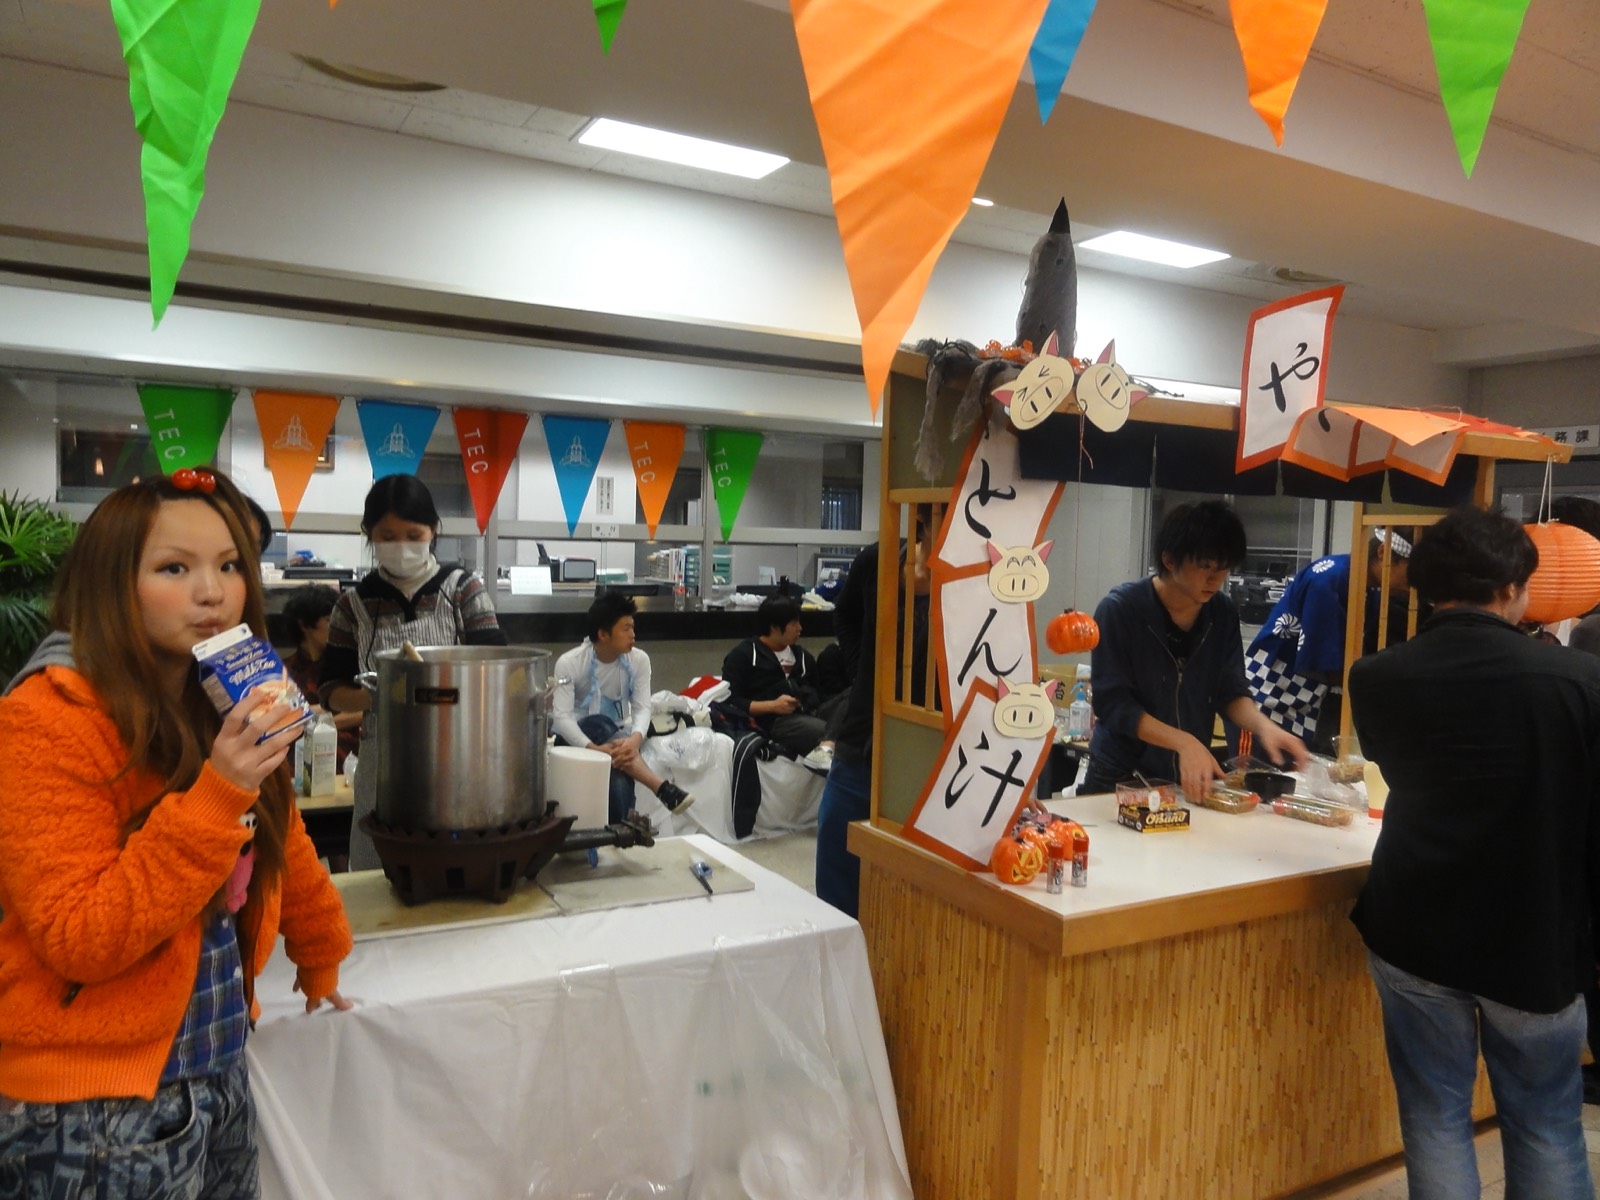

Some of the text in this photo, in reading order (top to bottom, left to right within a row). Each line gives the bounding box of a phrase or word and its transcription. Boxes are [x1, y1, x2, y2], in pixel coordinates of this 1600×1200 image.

[1258, 342, 1320, 414] や
[154, 408, 186, 461] TEC
[463, 427, 489, 475] TEC
[633, 441, 656, 484] TEC
[713, 448, 732, 488] TEC
